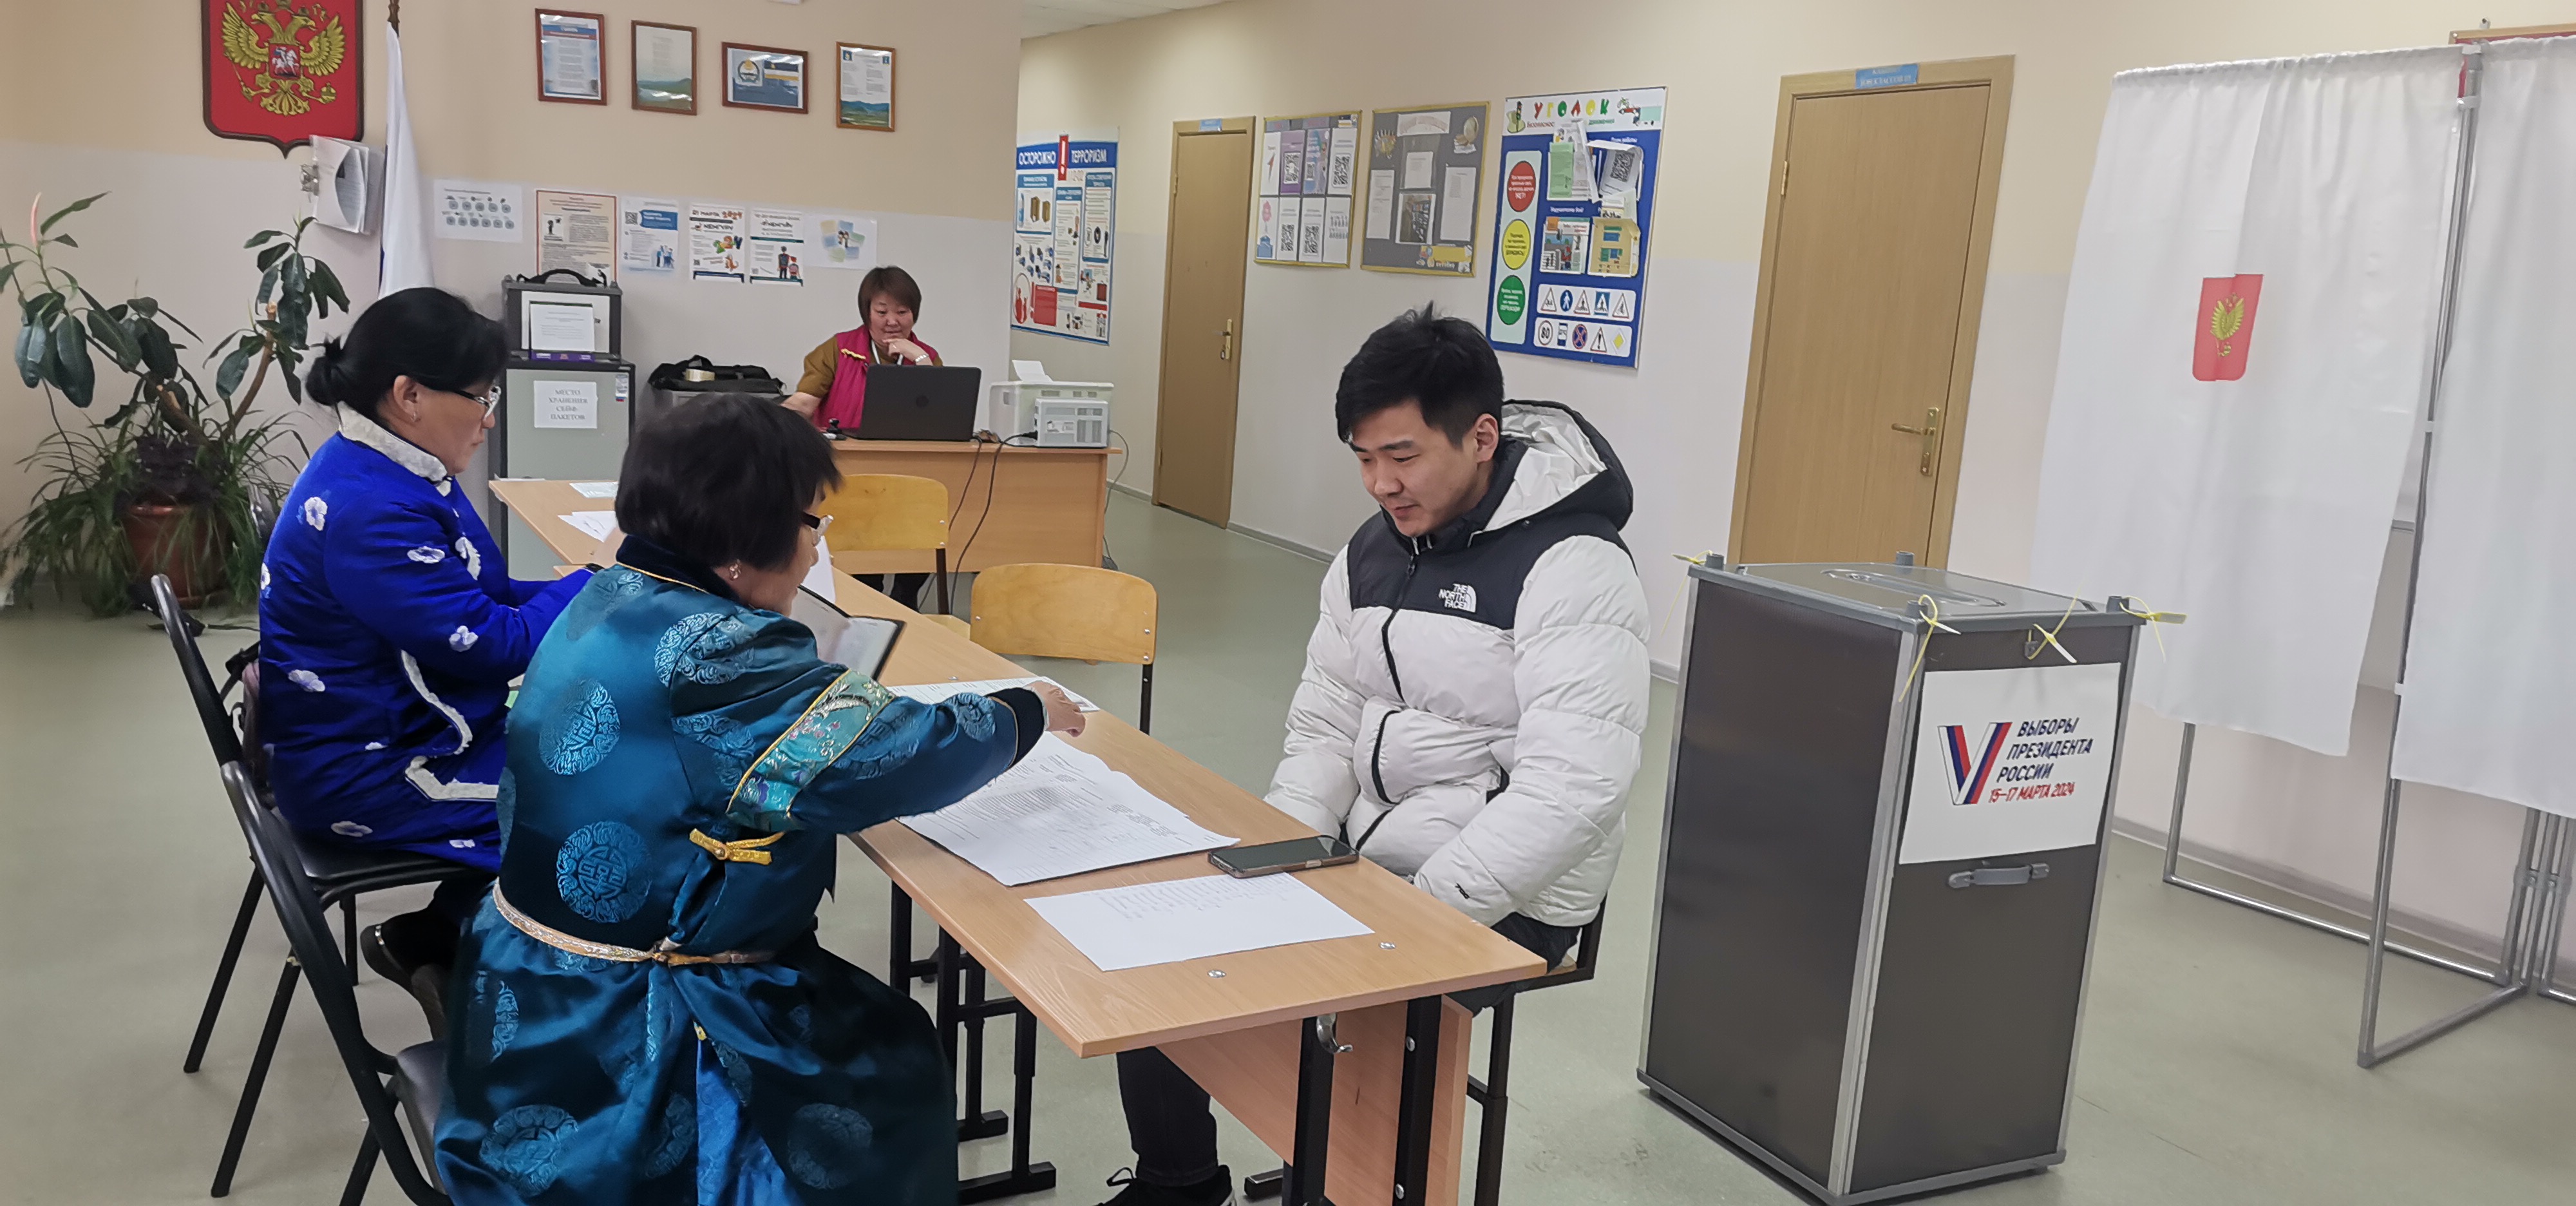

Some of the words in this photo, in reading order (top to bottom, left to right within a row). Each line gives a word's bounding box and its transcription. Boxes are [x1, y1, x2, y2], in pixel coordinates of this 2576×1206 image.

[1534, 99, 1609, 120] УГОЛОК
[1018, 151, 1056, 166] ОСТОРОЖНО
[1071, 149, 1107, 164] ТЕРРОРИЗМ
[1439, 589, 1466, 602] NORTH
[1453, 583, 1468, 593] THE
[1444, 598, 1466, 609] FACE
[2016, 717, 2079, 738] ВЫБОРЫ
[2006, 738, 2094, 760] ПРЕЗИДЕНТА
[1996, 763, 2054, 783] РОССИИ
[2016, 783, 2051, 801] МАРТА
[2050, 781, 2075, 797] 2024
